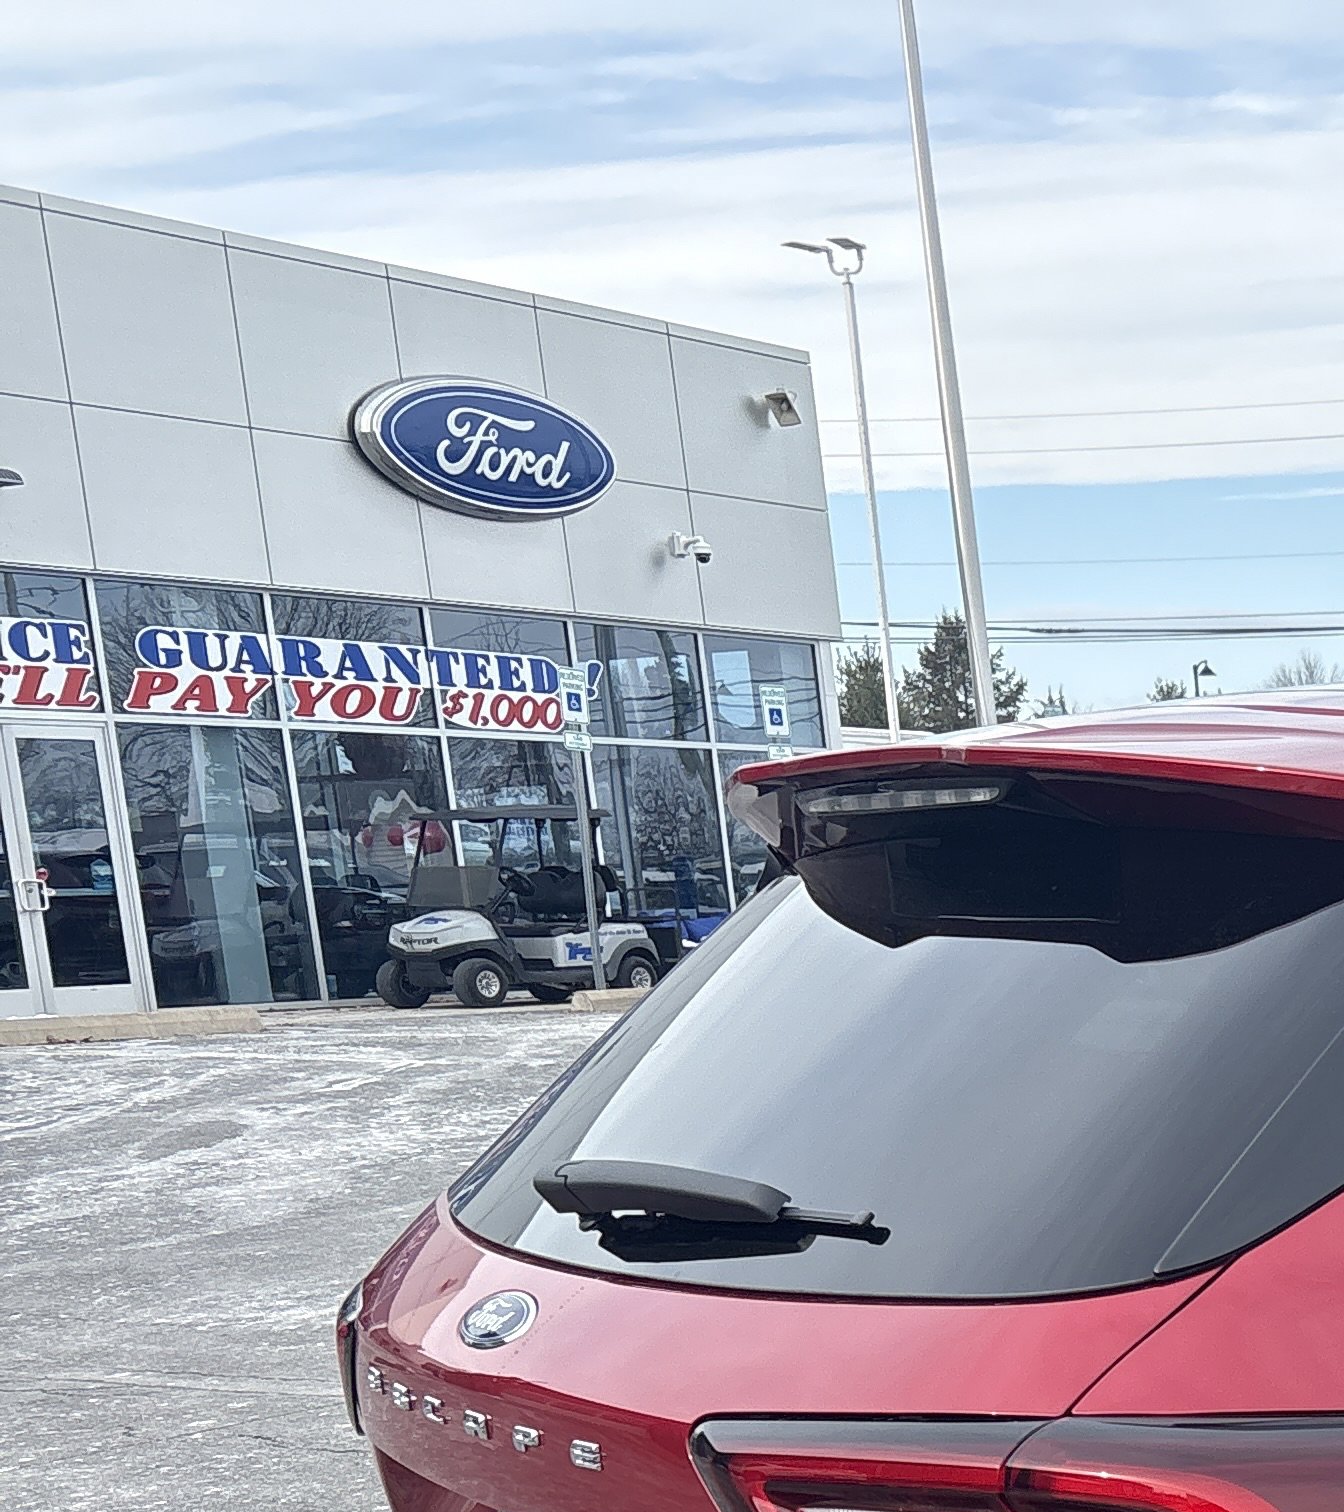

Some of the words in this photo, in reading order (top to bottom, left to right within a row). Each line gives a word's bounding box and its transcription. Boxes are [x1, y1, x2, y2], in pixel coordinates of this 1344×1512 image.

[437, 407, 571, 489] Ford
[0, 621, 92, 665] CE
[126, 670, 270, 714] PAY
[292, 680, 421, 721] YOU
[442, 689, 563, 730] $1,000
[466, 1298, 515, 1331] Ford
[366, 1365, 604, 1472] ESCAPE
